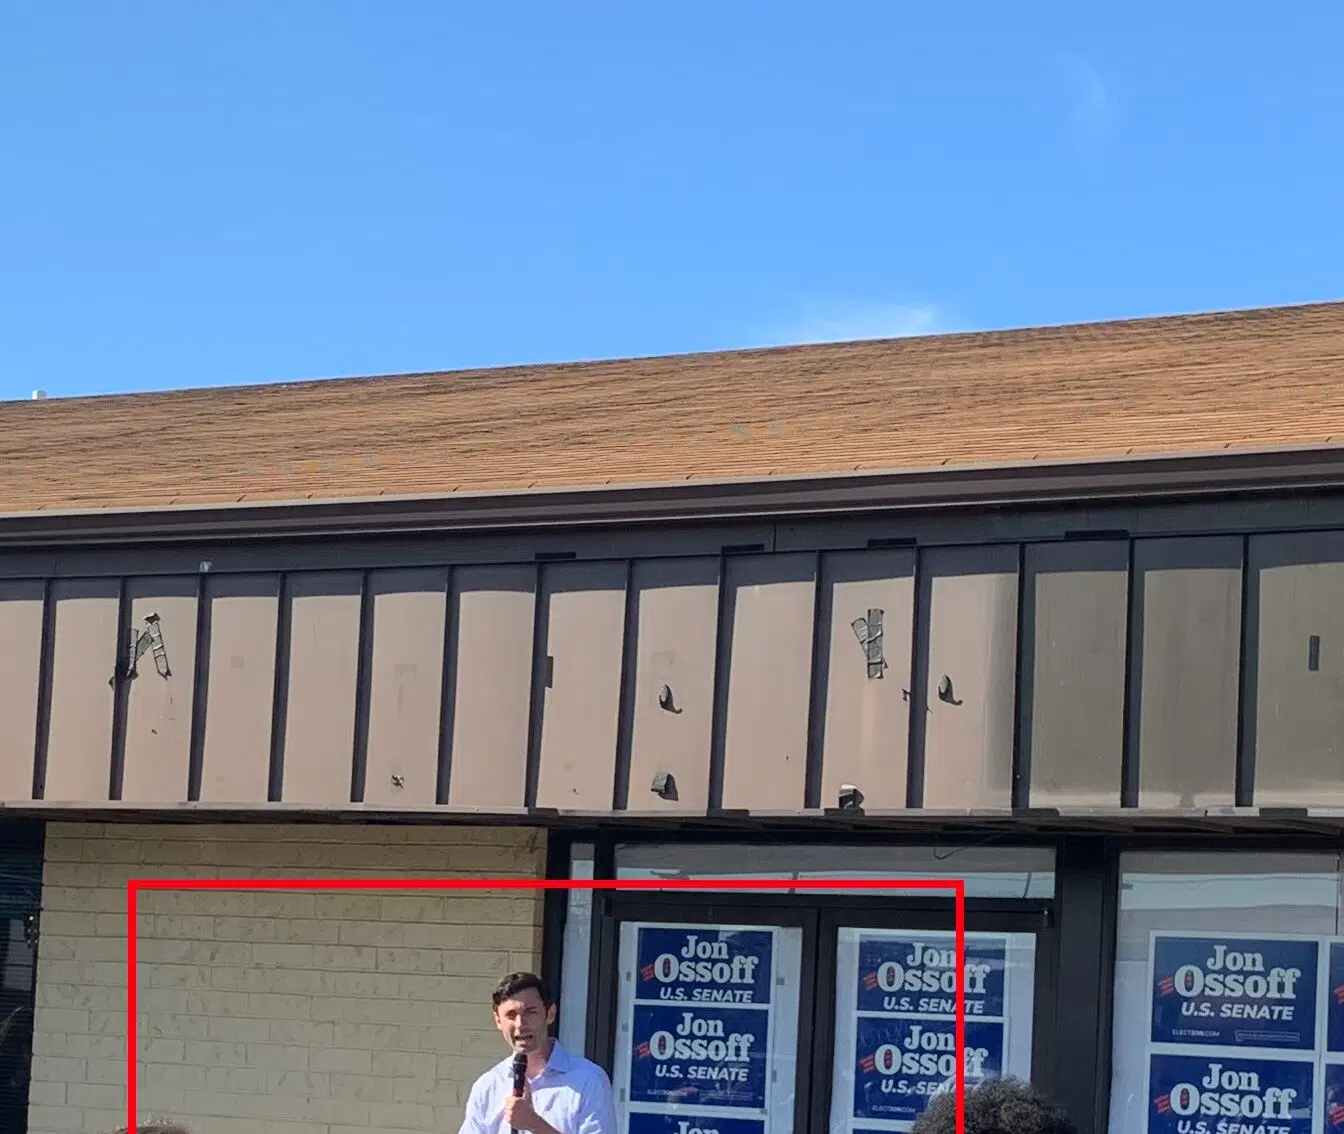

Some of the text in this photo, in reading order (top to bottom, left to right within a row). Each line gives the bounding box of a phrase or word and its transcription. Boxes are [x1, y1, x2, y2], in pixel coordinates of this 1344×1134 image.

[681, 935, 729, 959] Jon
[907, 942, 956, 968] Jon
[1207, 945, 1265, 972] Jon
[654, 953, 759, 984] Ossoff
[877, 961, 990, 994] Ossoff
[1174, 964, 1302, 999] Ossoff
[659, 986, 753, 1003] U.S. SENATE
[883, 996, 984, 1014] U.S. SENTE
[1181, 1001, 1295, 1021] U.S. SENATE
[676, 1012, 725, 1037] Jon
[649, 1030, 755, 1062] Ossoff
[904, 1025, 956, 1051] Jon
[655, 1064, 749, 1081] U.S. SENATE
[1202, 1063, 1261, 1091] Jon
[880, 1079, 956, 1096] U.S. SEN
[1169, 1082, 1297, 1119] Ossoff
